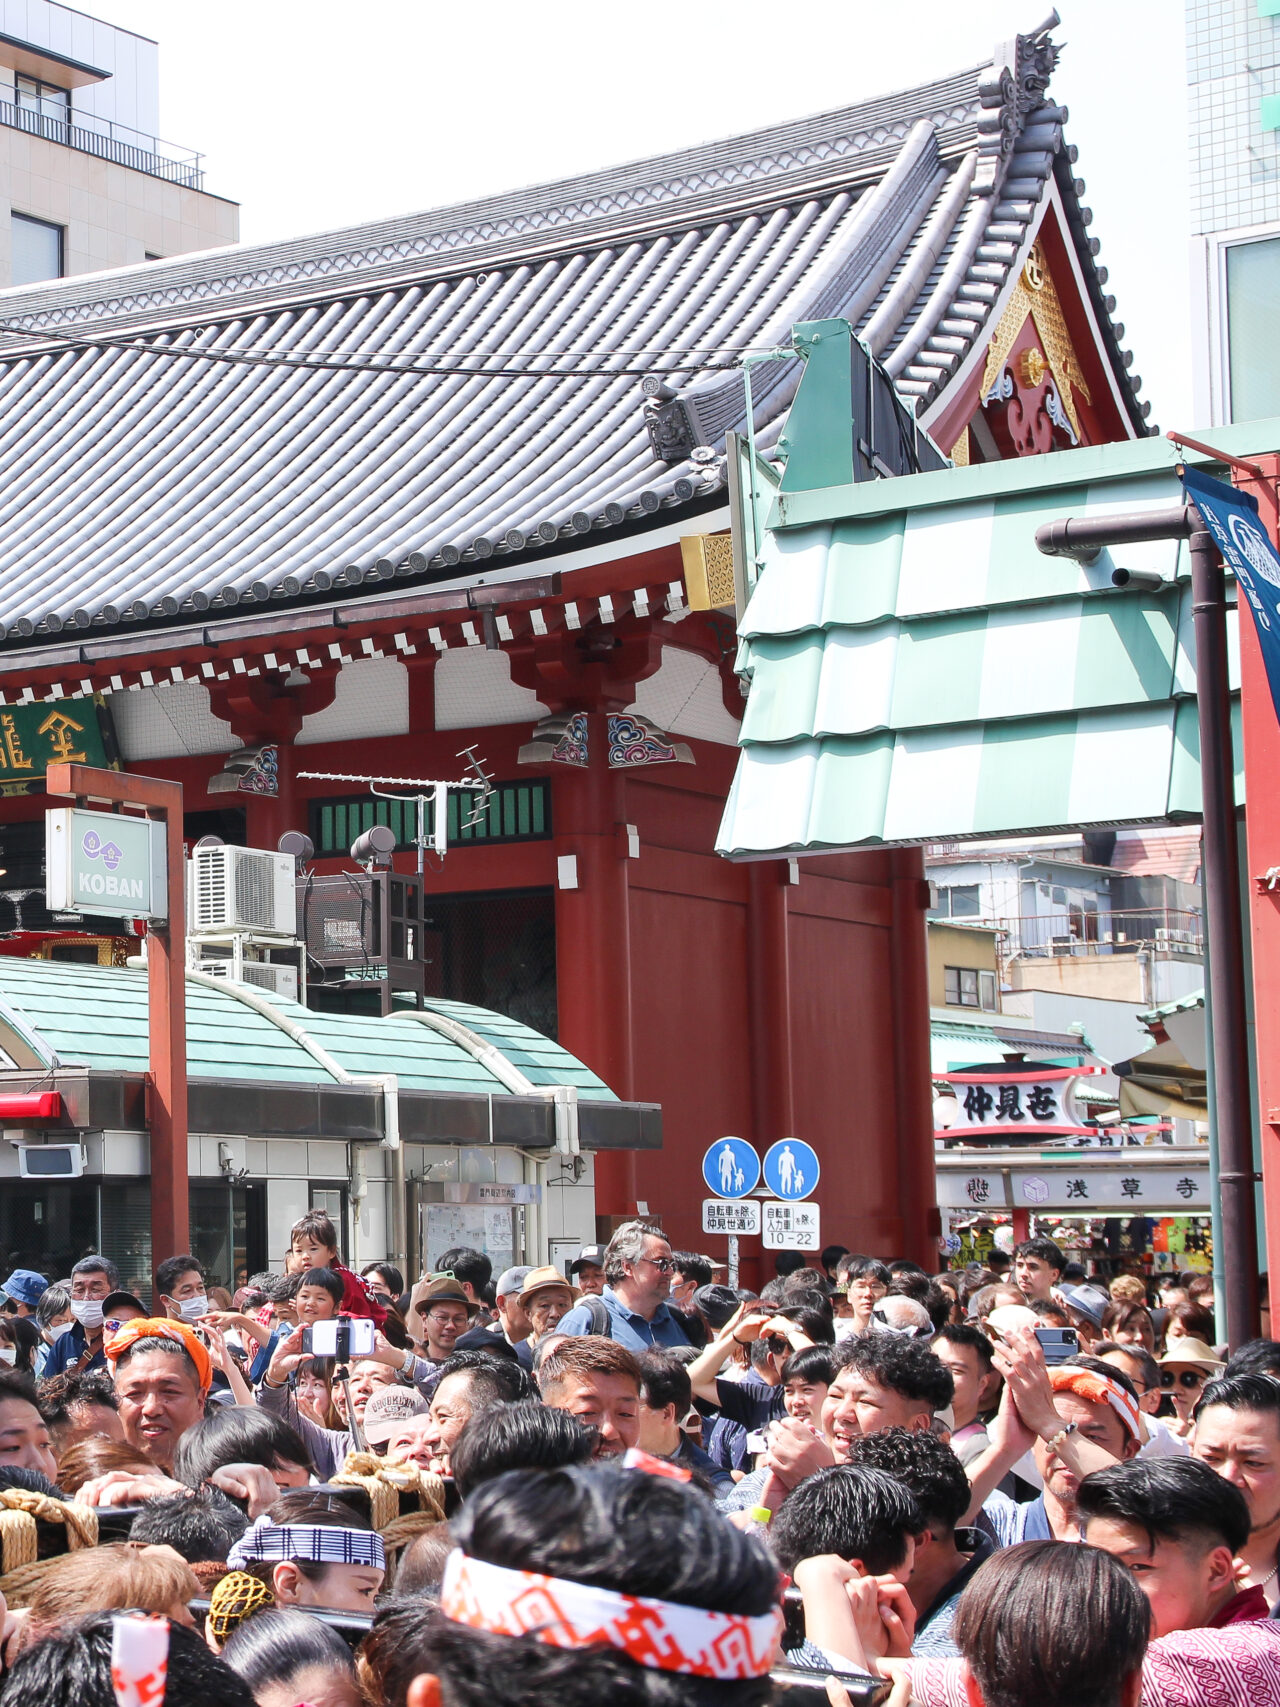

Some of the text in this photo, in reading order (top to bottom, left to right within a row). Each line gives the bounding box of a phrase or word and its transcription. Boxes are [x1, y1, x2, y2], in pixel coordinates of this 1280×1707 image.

[79, 872, 144, 899] KOBAN
[963, 1085, 1057, 1121] 仲見世
[1066, 1177, 1199, 1199] 浅草寺
[707, 1204, 757, 1217] 自転車を除く
[767, 1207, 791, 1219] 自転車
[707, 1218, 756, 1231] 仲見世通り
[767, 1219, 791, 1231] 人力車
[371, 1395, 416, 1413] BROOKLYN
